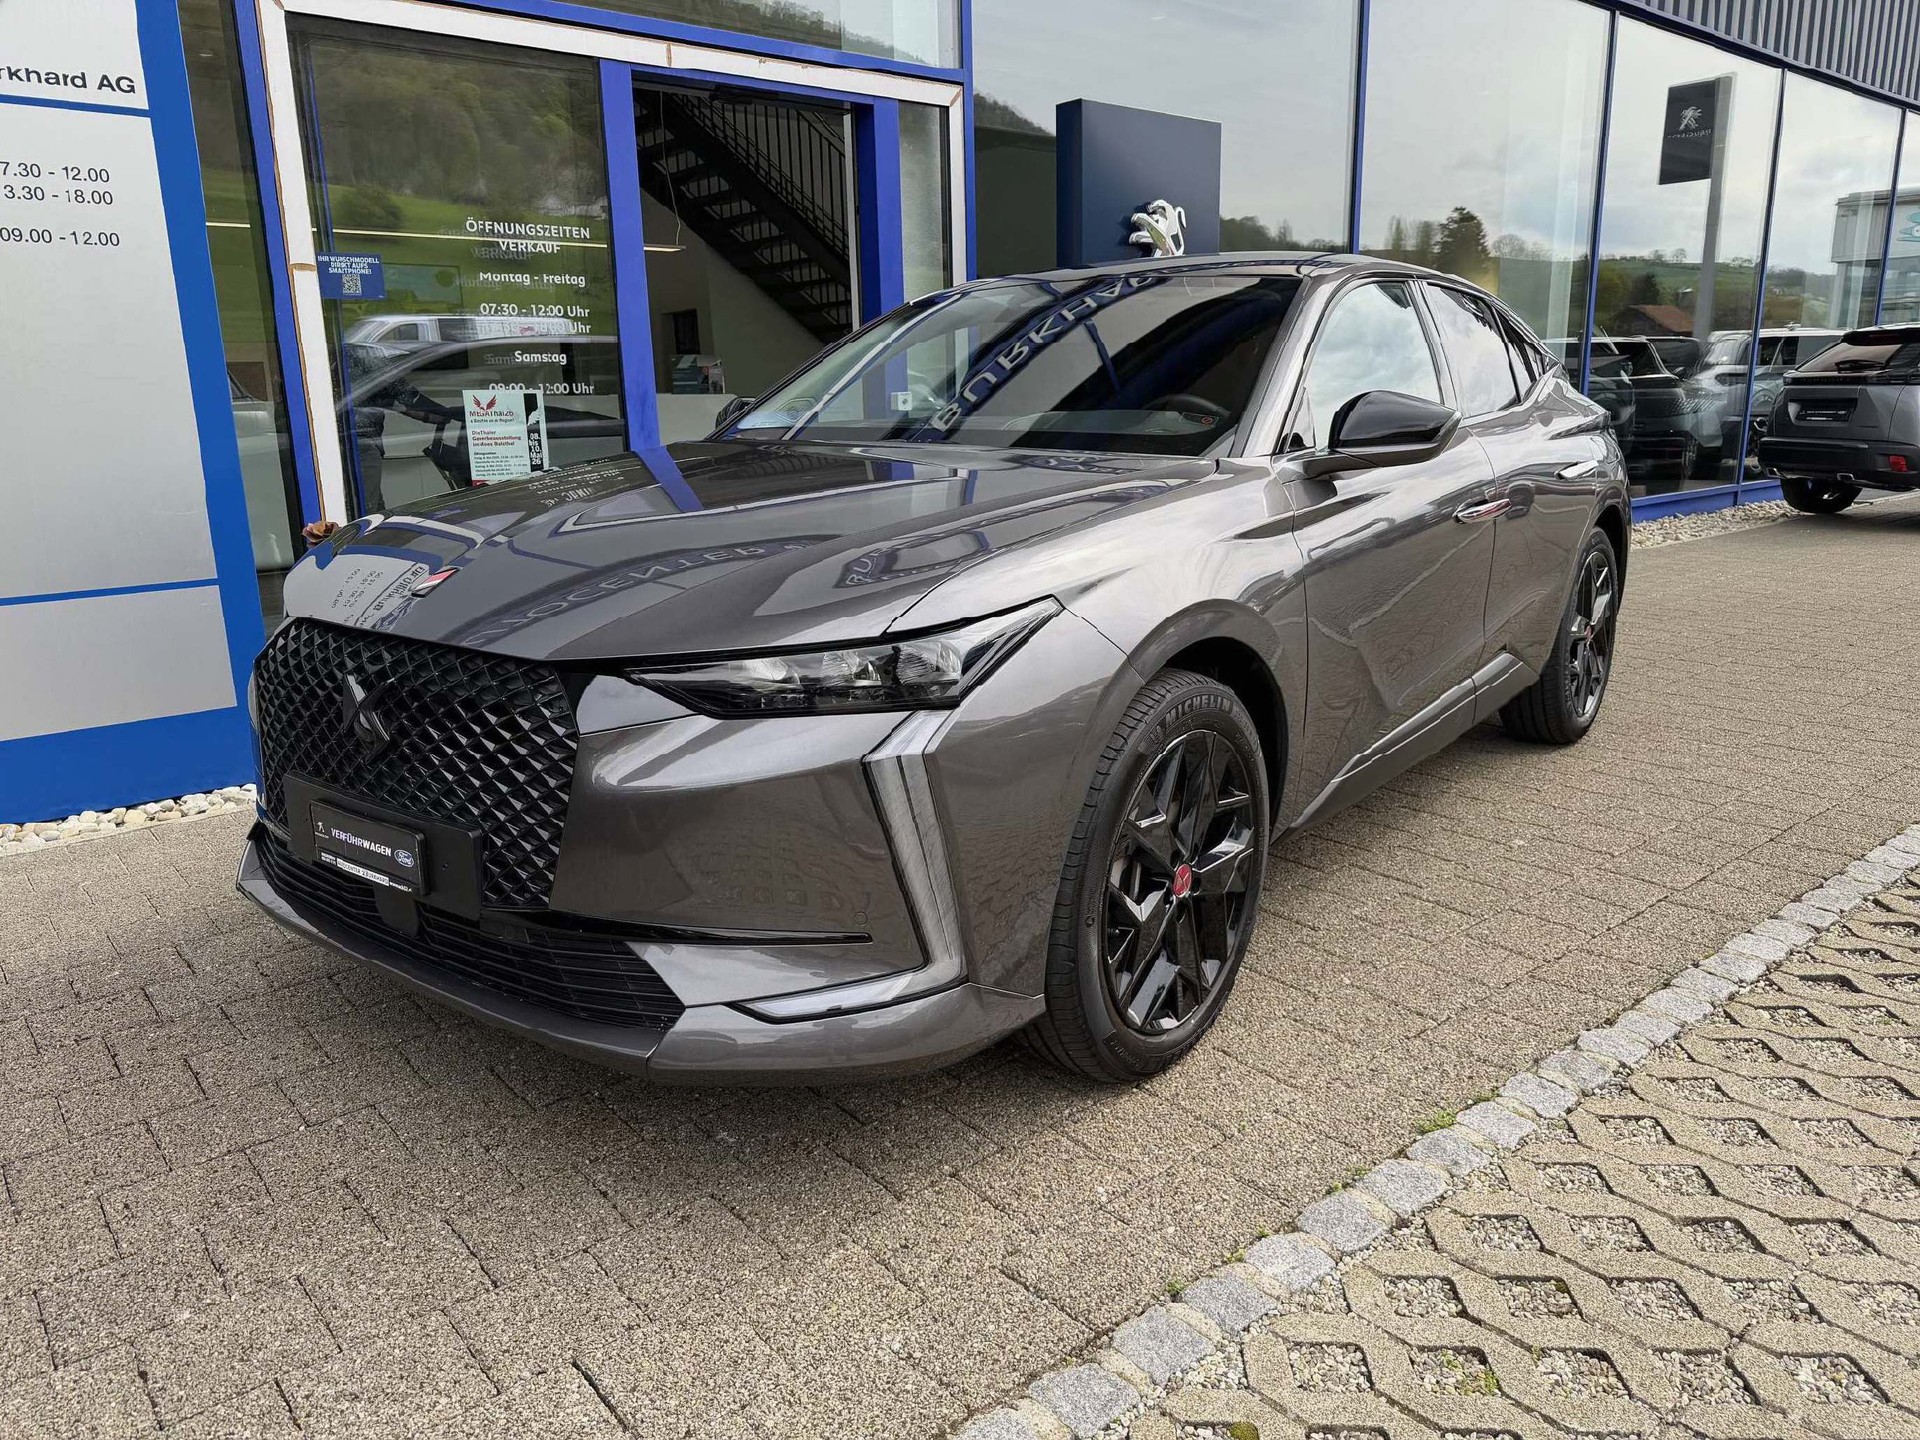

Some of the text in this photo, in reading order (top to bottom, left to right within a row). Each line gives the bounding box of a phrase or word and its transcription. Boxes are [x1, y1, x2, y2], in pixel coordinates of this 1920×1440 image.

[97, 74, 136, 94] AG
[61, 166, 110, 183] 12.00
[65, 189, 114, 205] 18.00
[465, 217, 591, 239] ÖFFNUNGSZEITEN
[0, 227, 52, 244] 09.00
[70, 230, 120, 247] 12.00
[499, 240, 561, 254] VERKAUF
[479, 271, 530, 285] Montag
[543, 273, 586, 287] Freitag
[480, 303, 518, 316] 07:30
[530, 304, 564, 317] 12:00
[567, 306, 590, 318] Uhr
[569, 322, 592, 334] Uhr
[514, 350, 567, 365] Samstag
[538, 383, 570, 395] 12:00
[572, 383, 595, 394] Uhr
[1165, 694, 1232, 729] MICHELIN
[331, 828, 392, 857] VERFÜHRWAGEN
